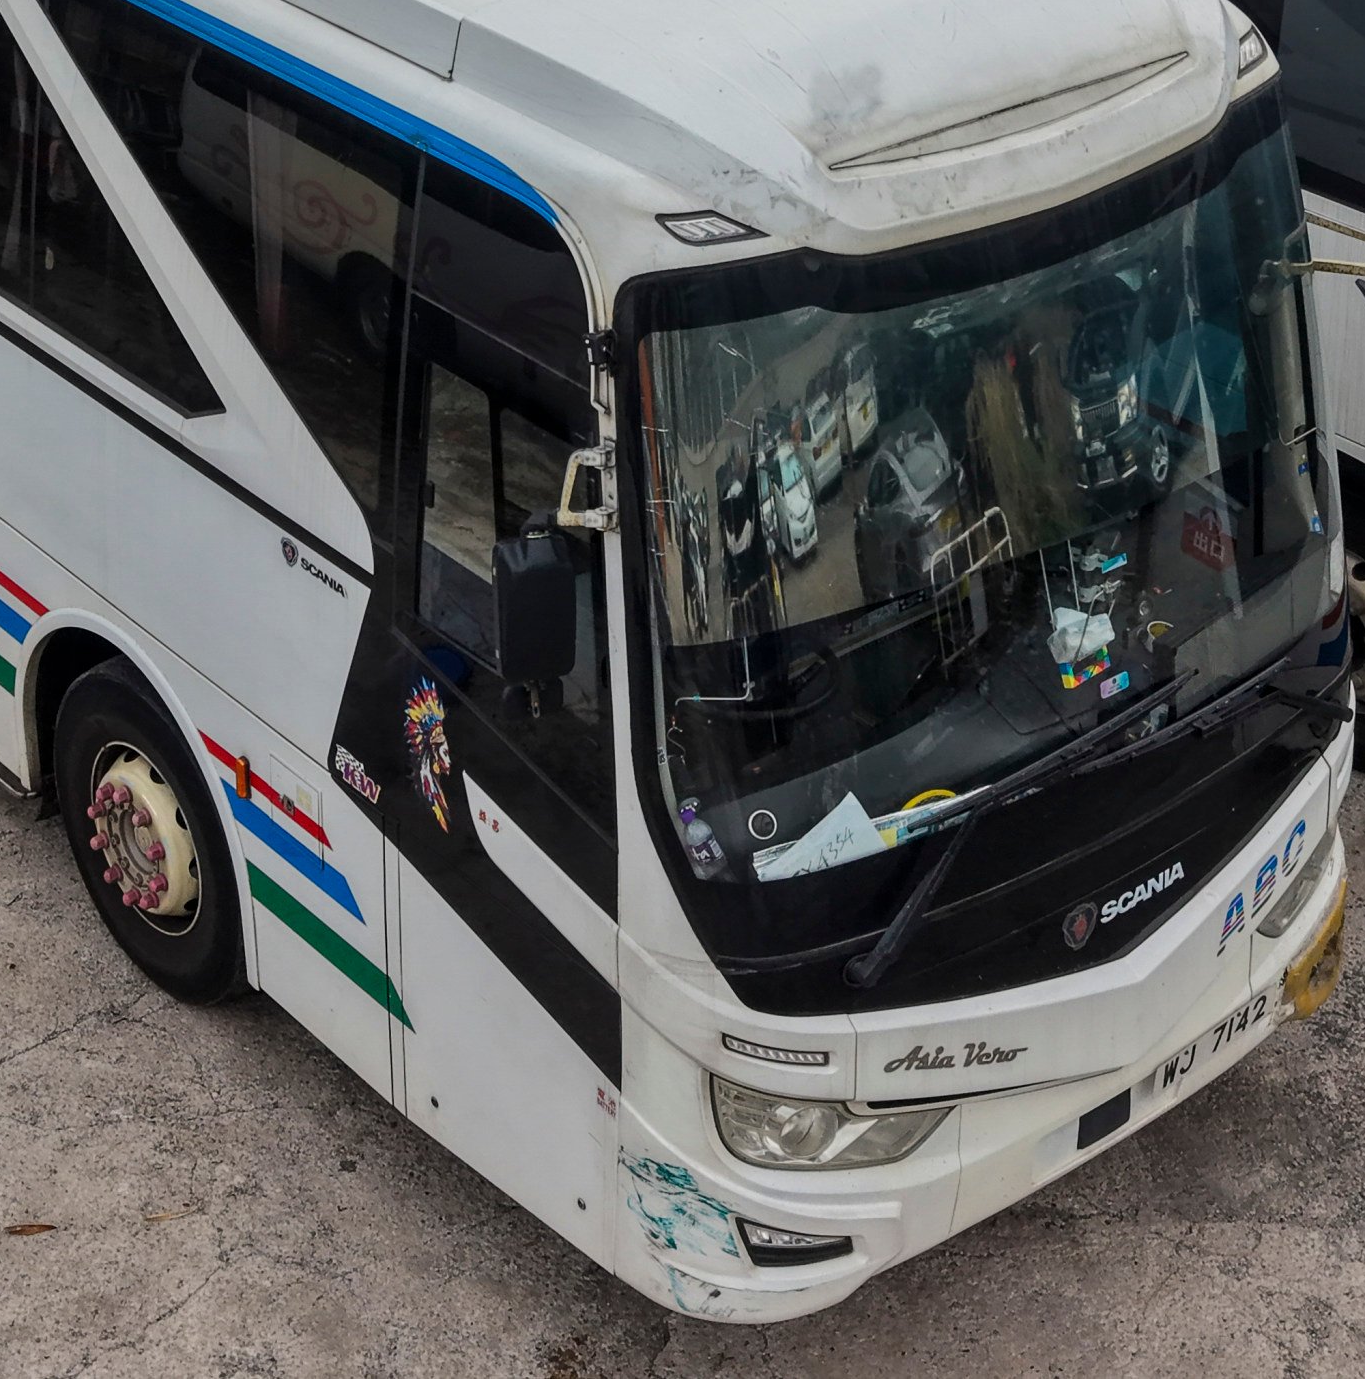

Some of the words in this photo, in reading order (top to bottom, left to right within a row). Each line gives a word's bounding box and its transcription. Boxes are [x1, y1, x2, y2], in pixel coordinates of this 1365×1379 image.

[1193, 530, 1226, 562] 出口
[300, 556, 348, 599] SCANIA
[1100, 861, 1185, 924] SCANIA
[1216, 819, 1306, 957] ABC
[883, 1044, 956, 1074] Asia
[963, 1041, 1029, 1068] Vero
[1162, 1043, 1197, 1089] WJ
[1212, 994, 1267, 1053] 7142
